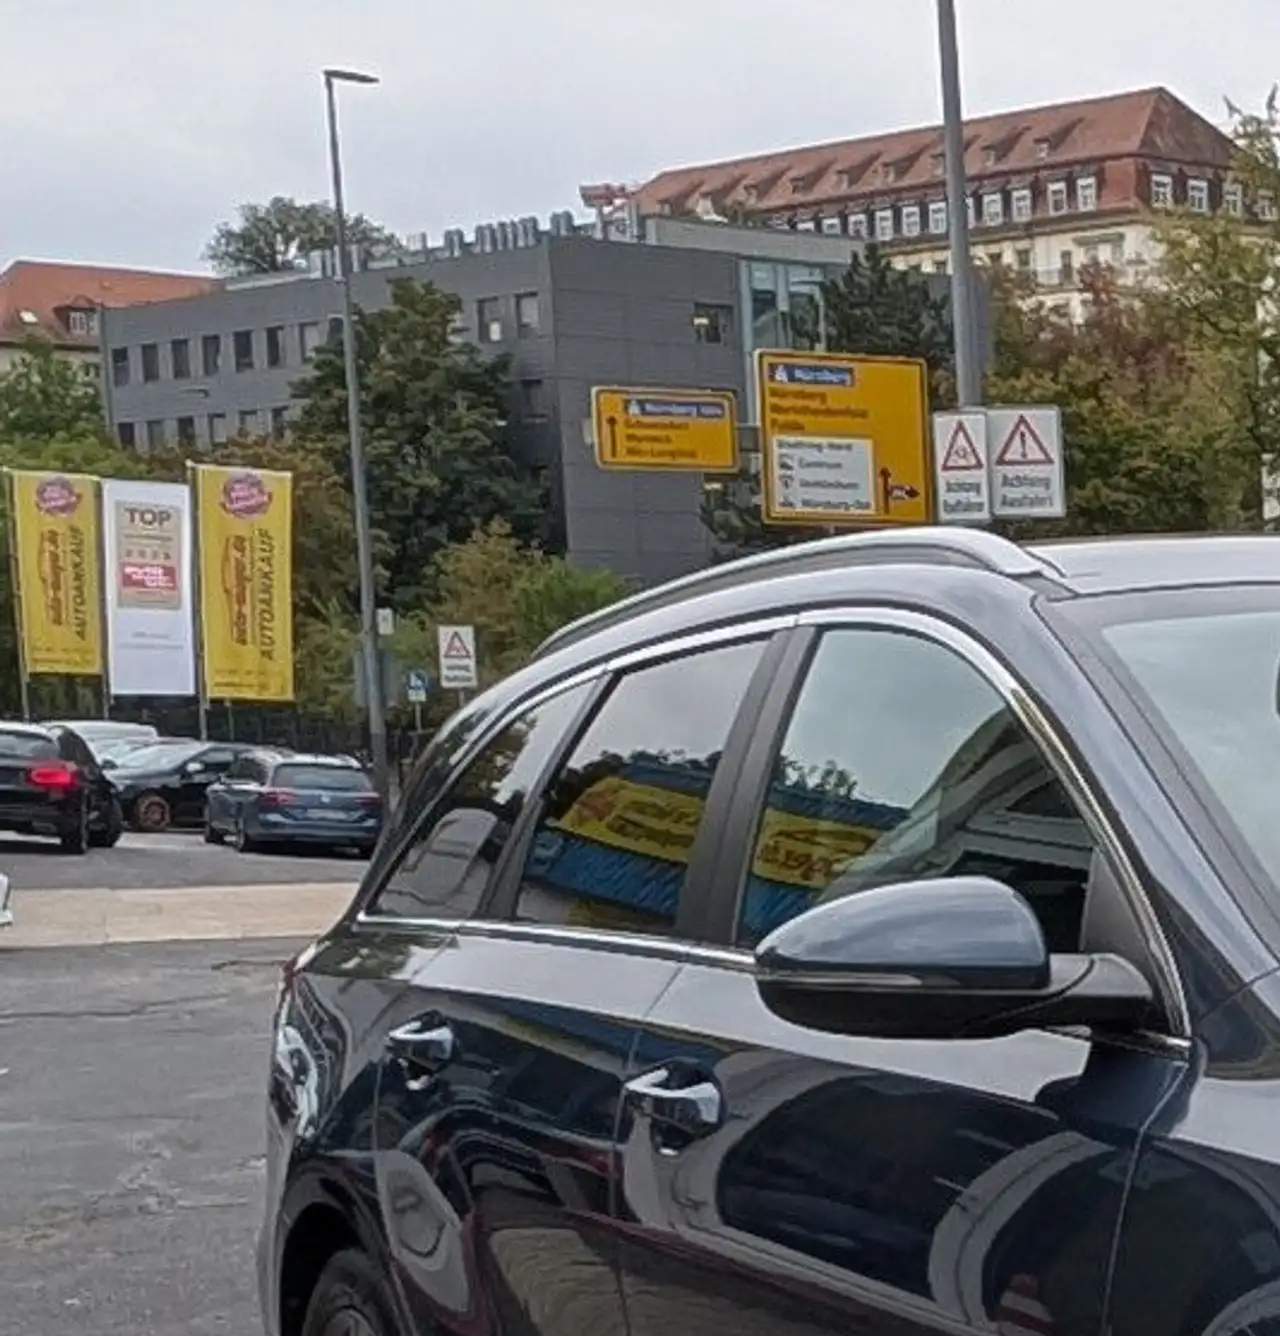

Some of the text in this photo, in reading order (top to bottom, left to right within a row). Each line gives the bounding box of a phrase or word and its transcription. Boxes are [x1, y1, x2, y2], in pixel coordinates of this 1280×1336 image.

[124, 507, 172, 526] TOP
[69, 523, 86, 642] AUTOANKAUF
[257, 527, 276, 662] AUTOANKAUF
